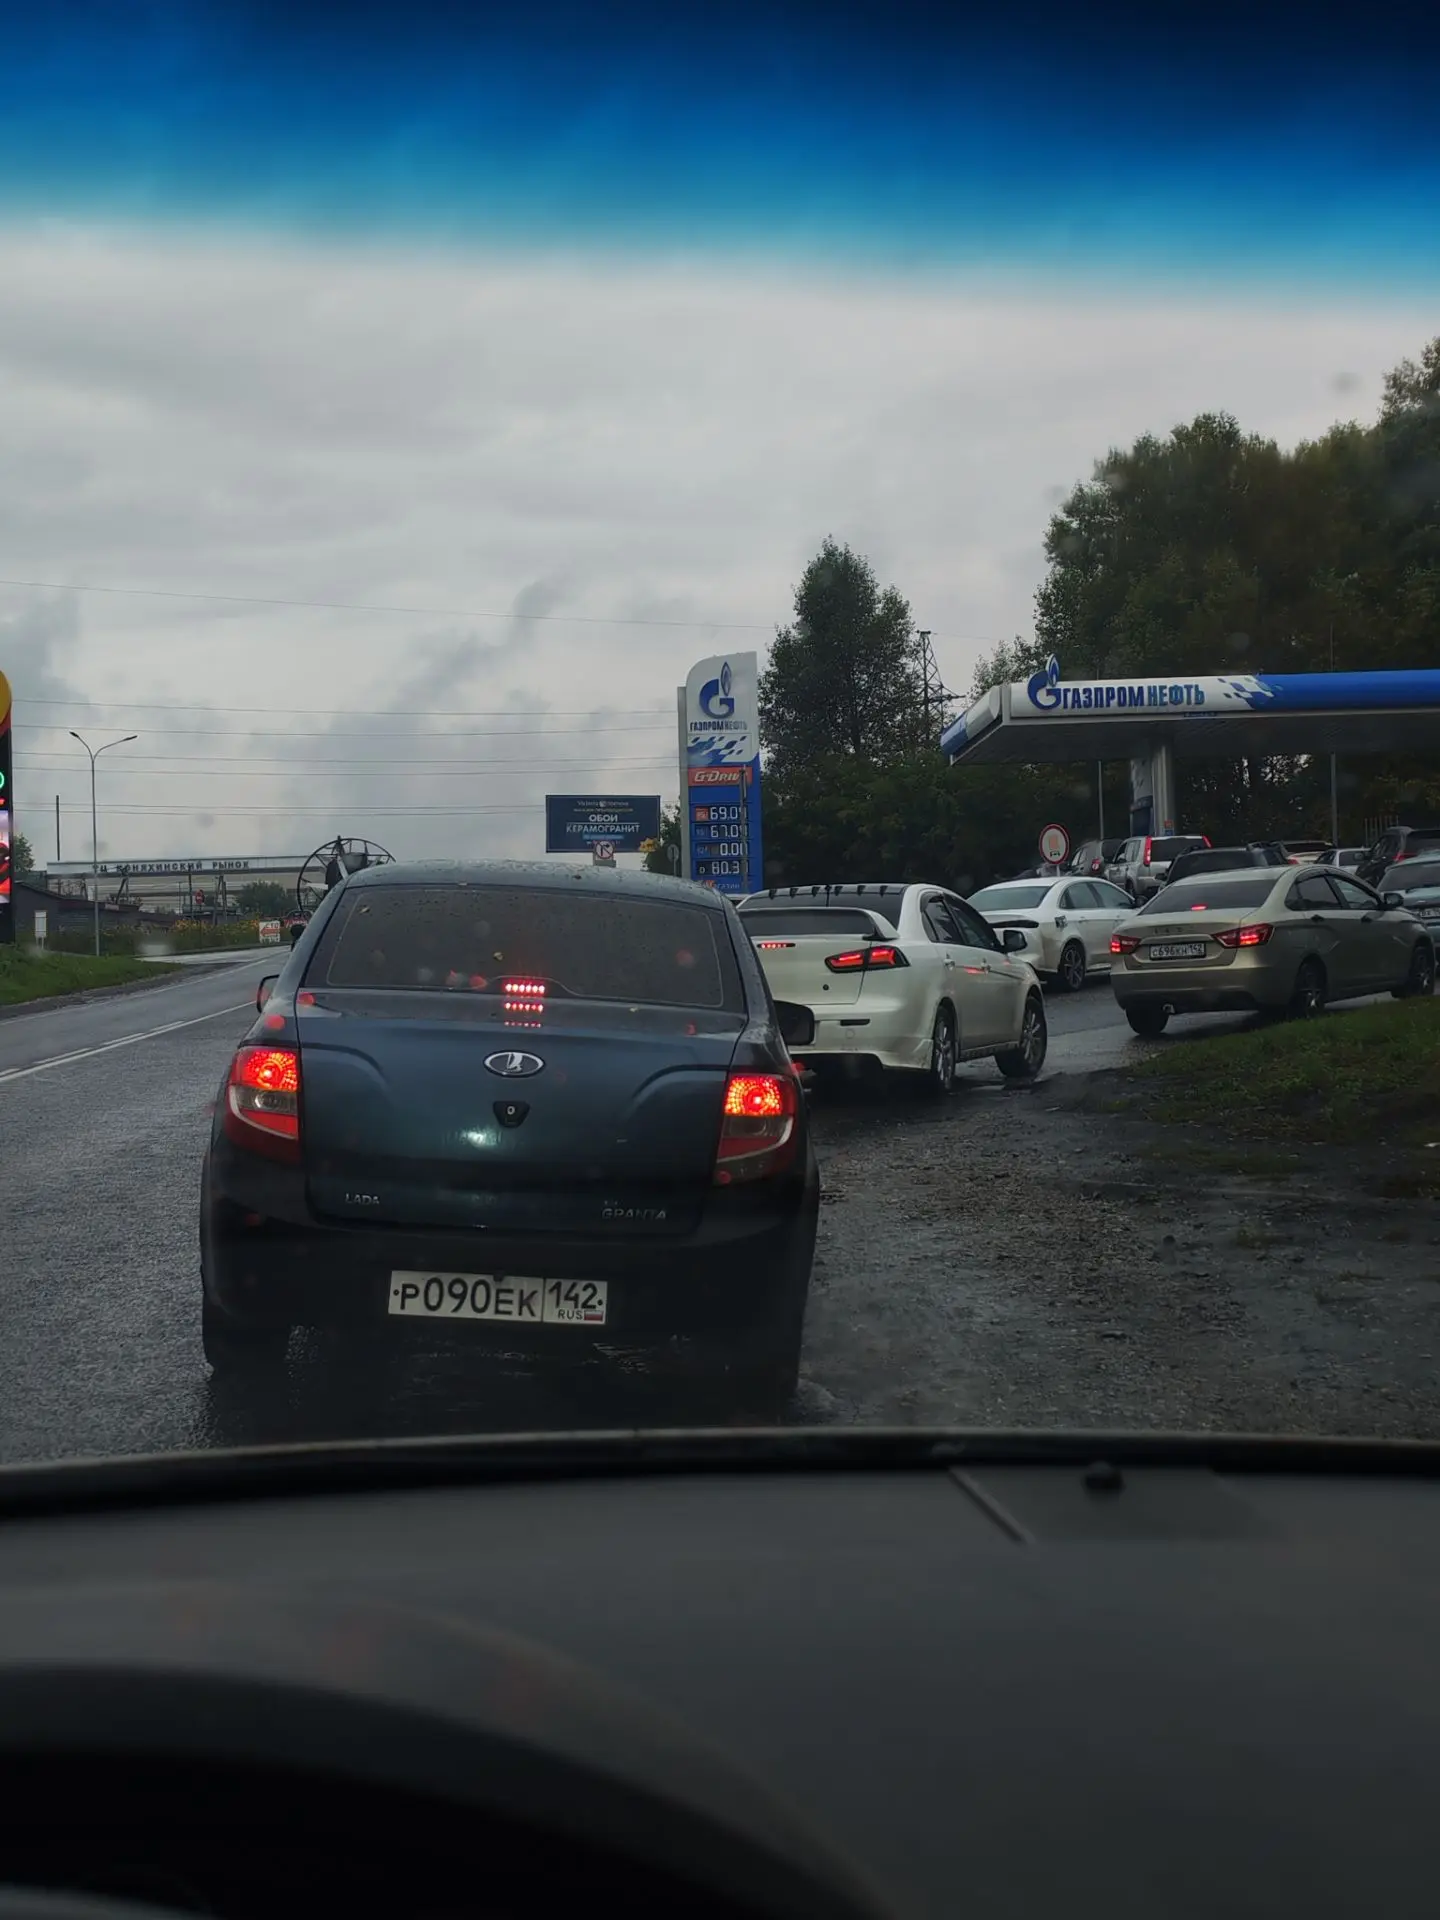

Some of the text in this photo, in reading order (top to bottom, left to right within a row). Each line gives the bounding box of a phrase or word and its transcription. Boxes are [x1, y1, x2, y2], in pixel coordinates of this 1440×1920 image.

[1063, 684, 1205, 709] ГАЗПРОМНЕФТЬ
[588, 814, 618, 823] ОБОИ
[566, 825, 640, 833] КЕРАМОГРАНИТ
[212, 861, 250, 870] РЫНОК
[345, 1193, 380, 1205] LADA
[548, 1280, 598, 1310] 142
[558, 1308, 583, 1320] RUS
